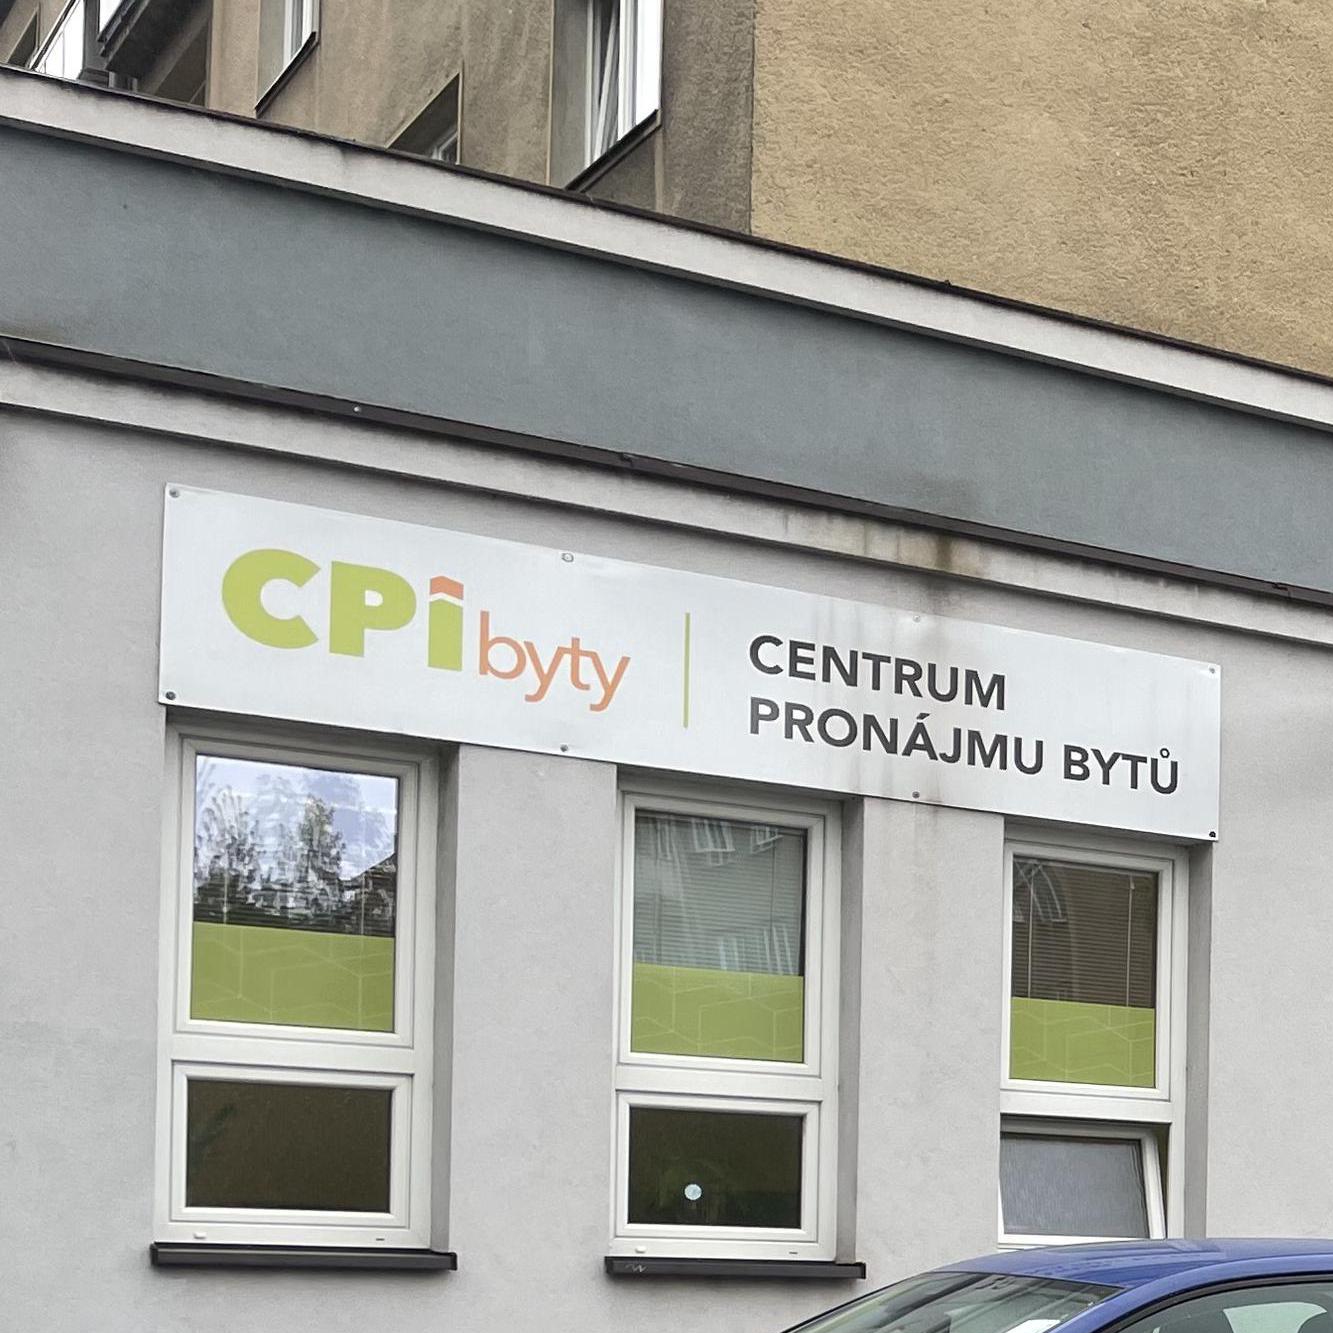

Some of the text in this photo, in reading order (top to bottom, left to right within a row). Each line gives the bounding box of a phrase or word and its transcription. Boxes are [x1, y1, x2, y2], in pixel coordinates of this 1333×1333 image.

[748, 634, 1006, 711] CENTRUM
[748, 696, 1179, 795] PRONÁJMU BYTŮ
